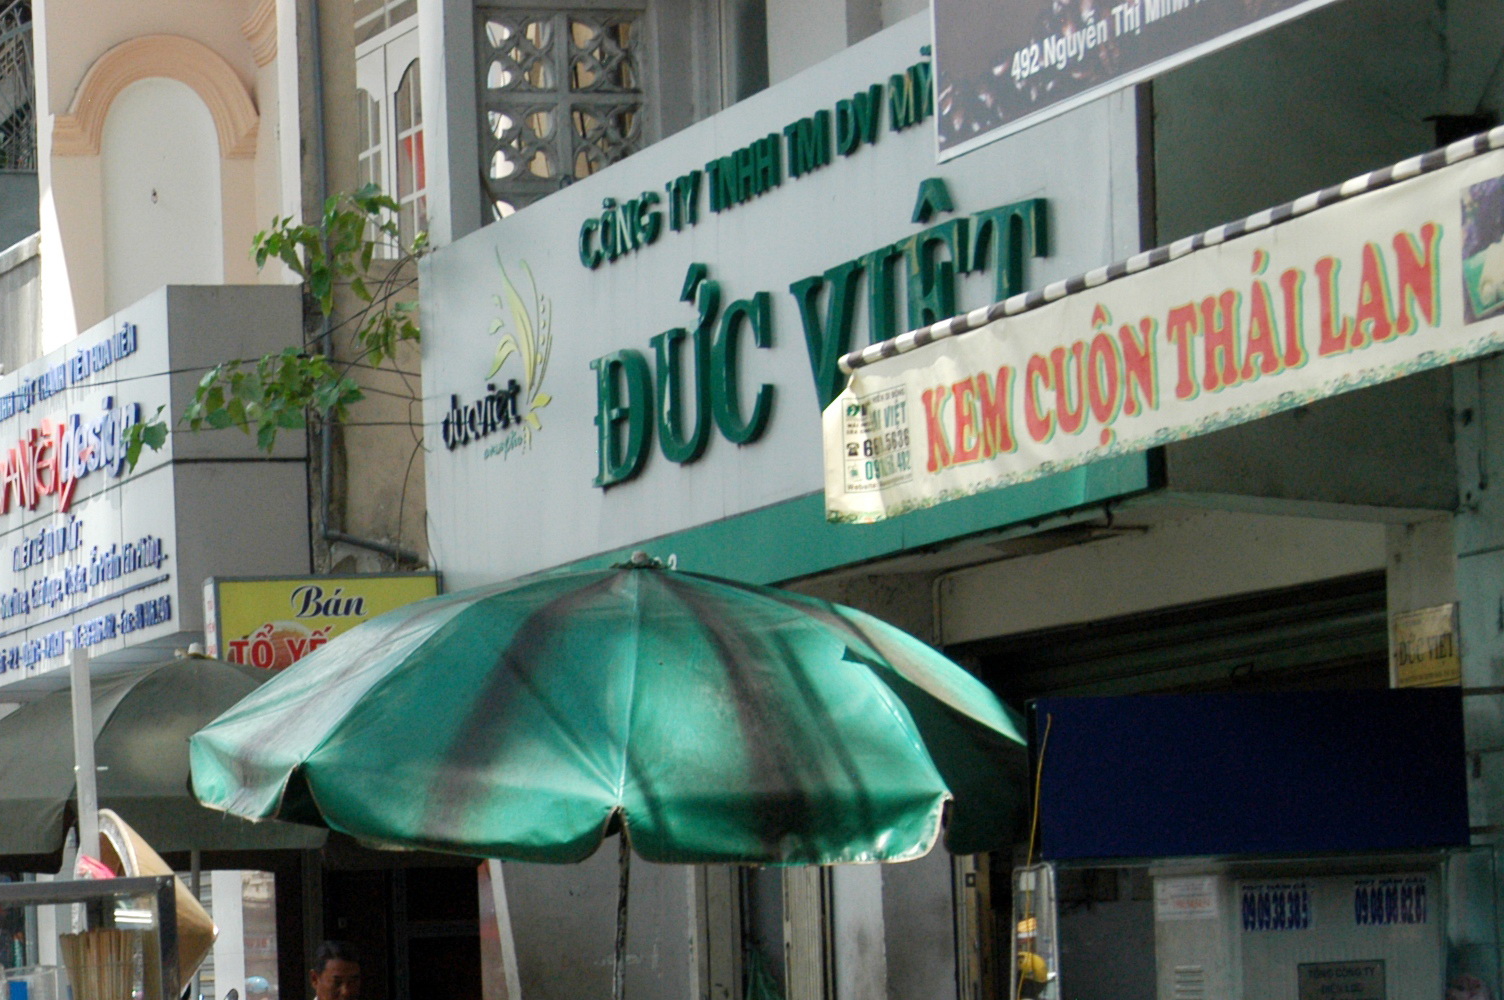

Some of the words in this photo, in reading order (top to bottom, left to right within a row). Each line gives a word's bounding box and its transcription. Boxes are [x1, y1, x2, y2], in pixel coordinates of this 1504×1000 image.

[1011, 43, 1040, 81] 492
[1043, 15, 1108, 70] Nguyễn
[1111, 0, 1141, 36] Thị
[579, 191, 662, 270] CÔNG
[665, 170, 702, 233] TY
[705, 130, 780, 214] TNHH
[783, 109, 830, 179] TM
[836, 84, 883, 157] DV
[592, 261, 774, 491] ĐỨC
[921, 363, 1017, 474] KEM
[1024, 302, 1158, 446] CUỘN
[1166, 249, 1306, 402] THÁI
[1313, 221, 1444, 357] LAN
[229, 623, 276, 670] TỔ
[285, 625, 328, 663] YẾ
[291, 585, 368, 619] Bán
